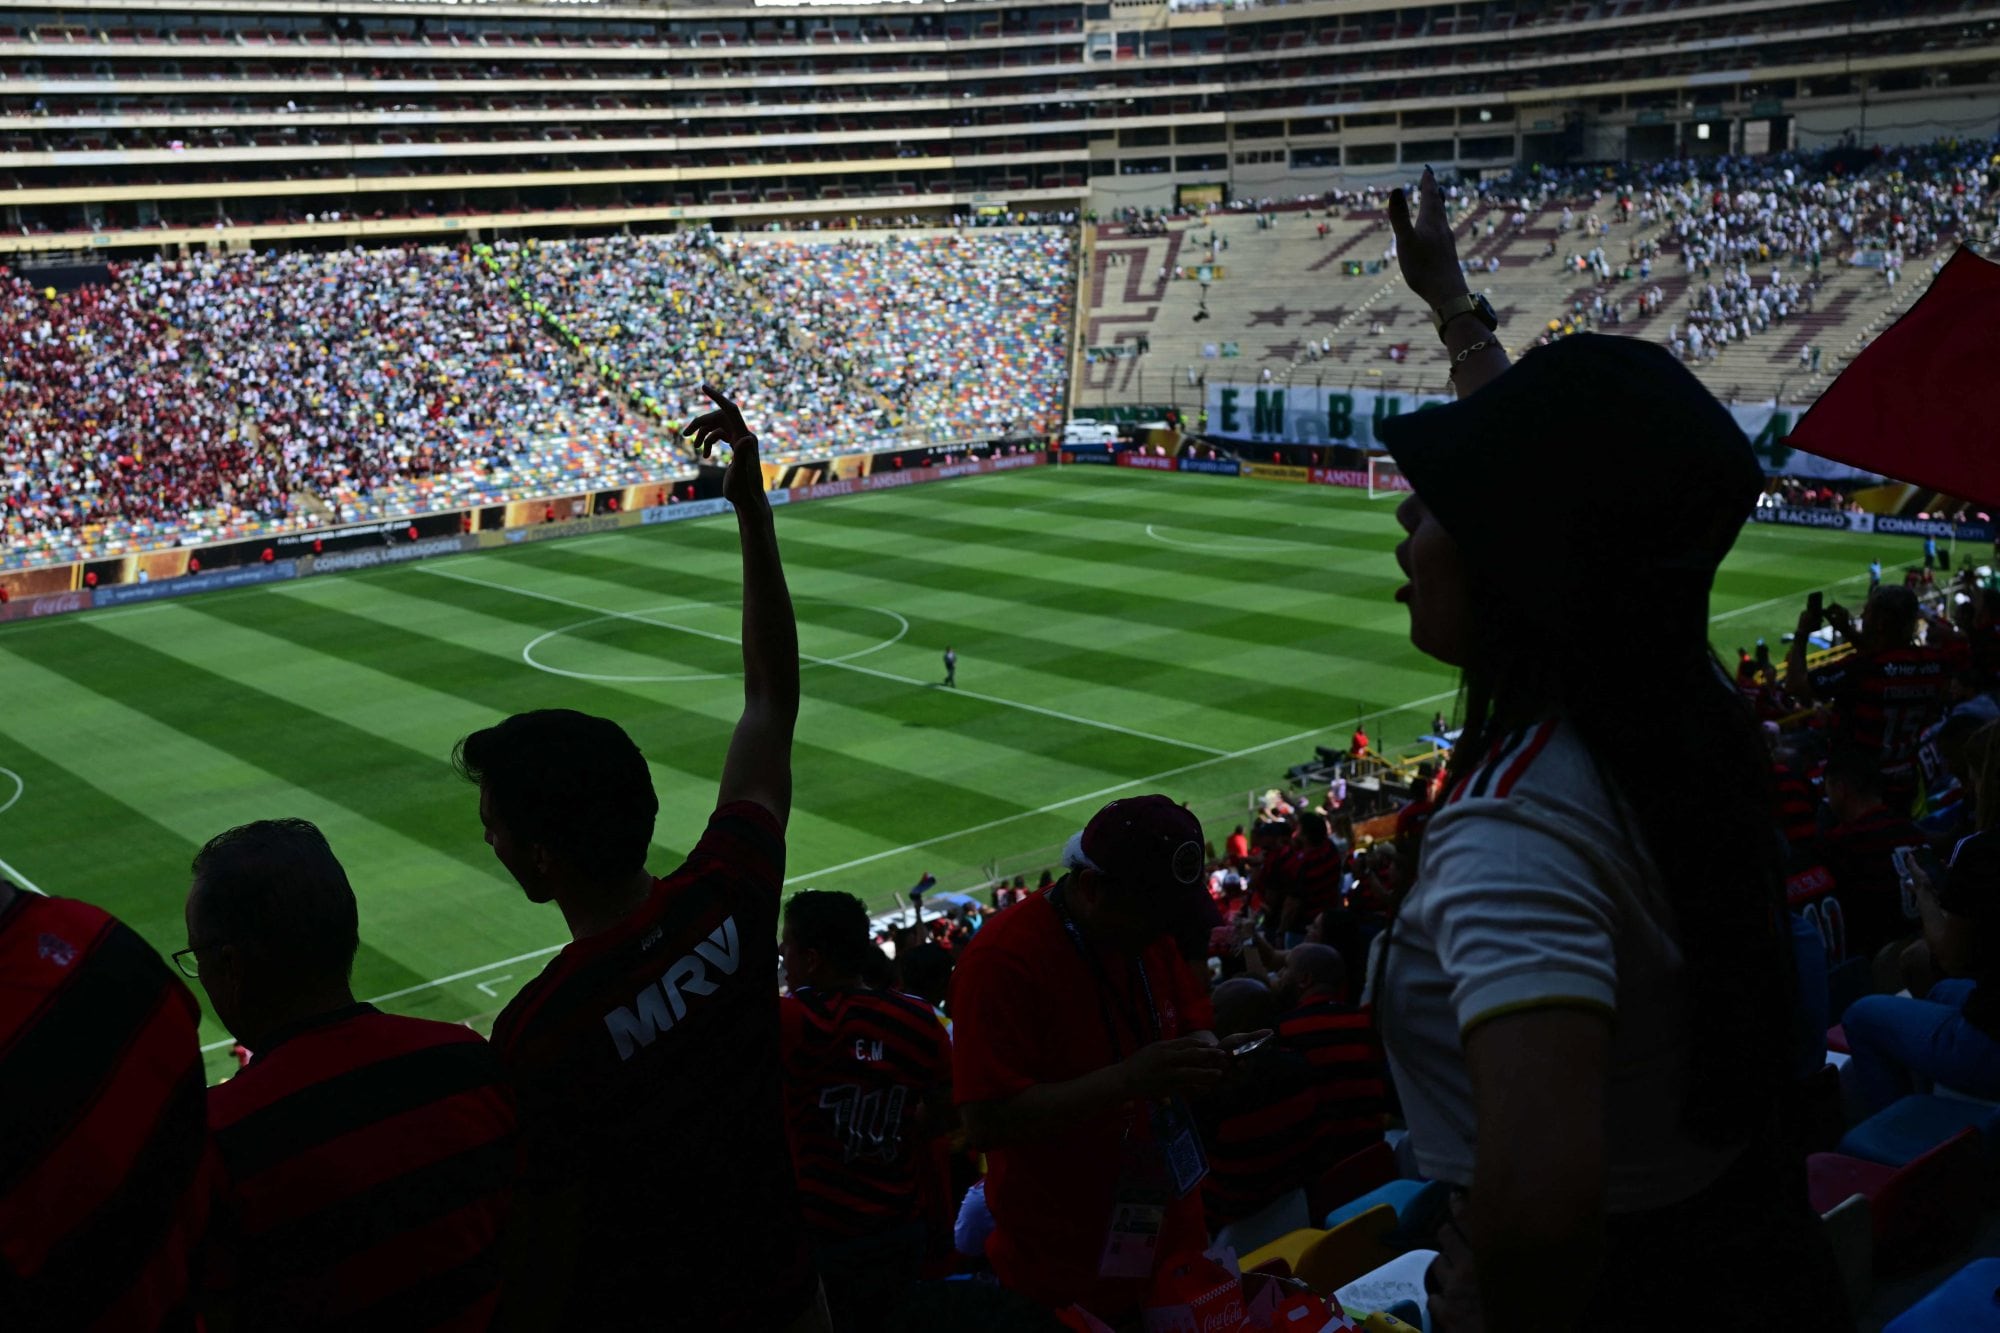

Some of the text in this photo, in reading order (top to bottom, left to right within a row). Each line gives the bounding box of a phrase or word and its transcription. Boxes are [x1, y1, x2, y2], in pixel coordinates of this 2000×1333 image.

[1221, 388, 1284, 434] EM
[1325, 469, 1369, 488] AMSTEL
[1756, 509, 1845, 527] DE RACISMO
[603, 914, 741, 1062] MRV
[855, 1038, 884, 1062] E.M
